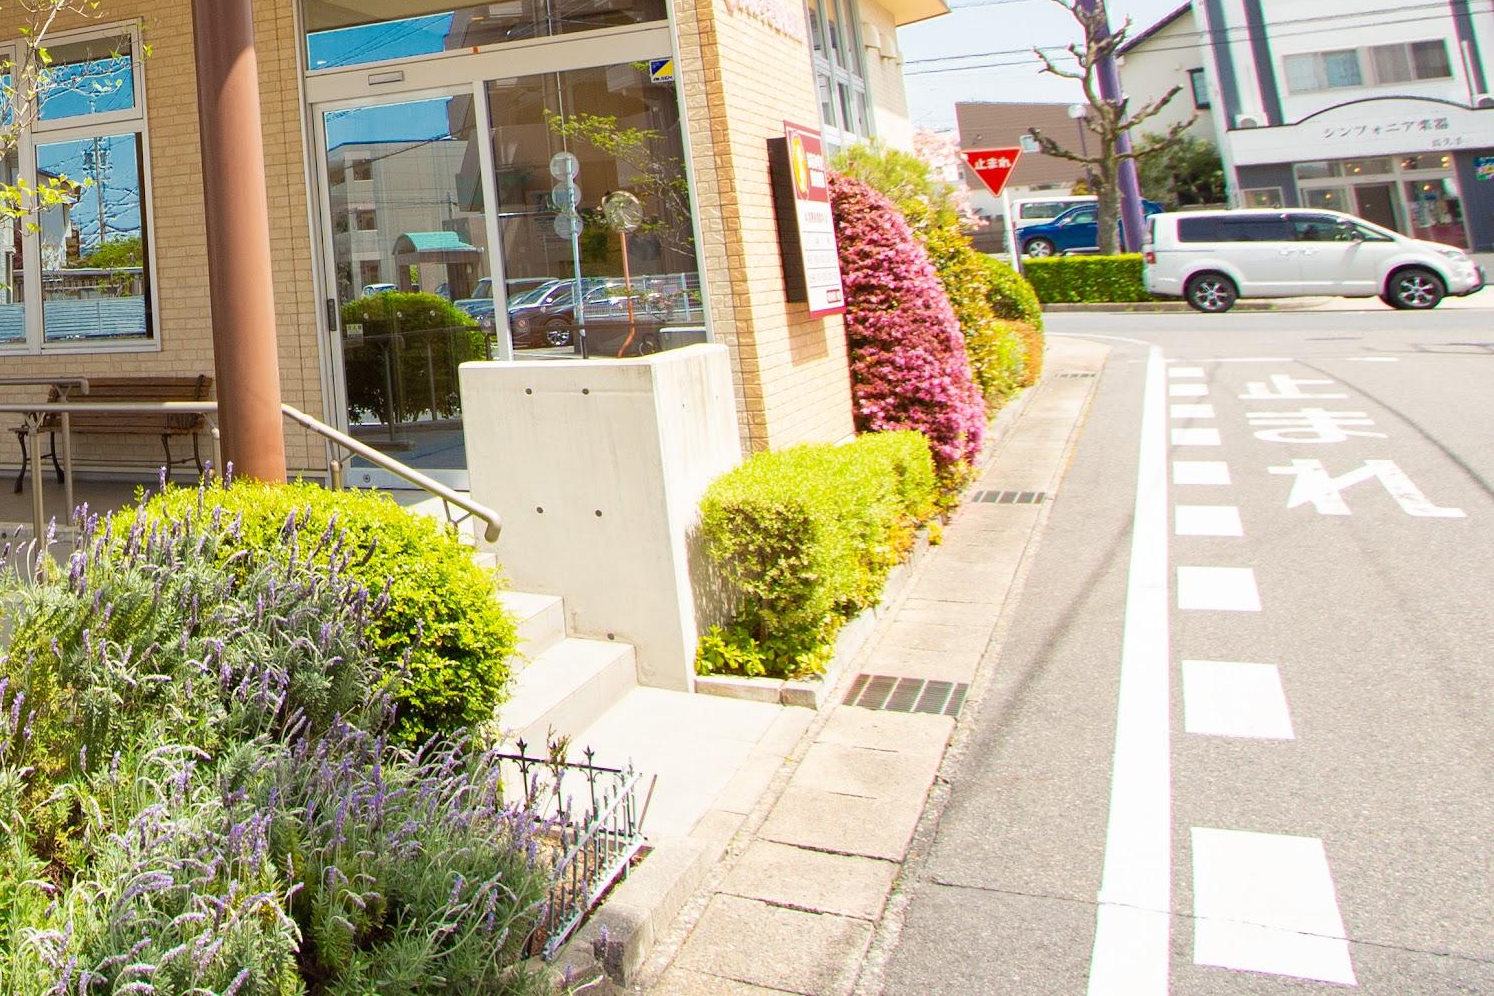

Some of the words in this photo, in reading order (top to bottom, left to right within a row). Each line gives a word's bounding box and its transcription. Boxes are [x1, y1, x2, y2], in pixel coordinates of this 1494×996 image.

[974, 157, 1012, 170] 止まれ
[1238, 374, 1468, 518] 止まれ
